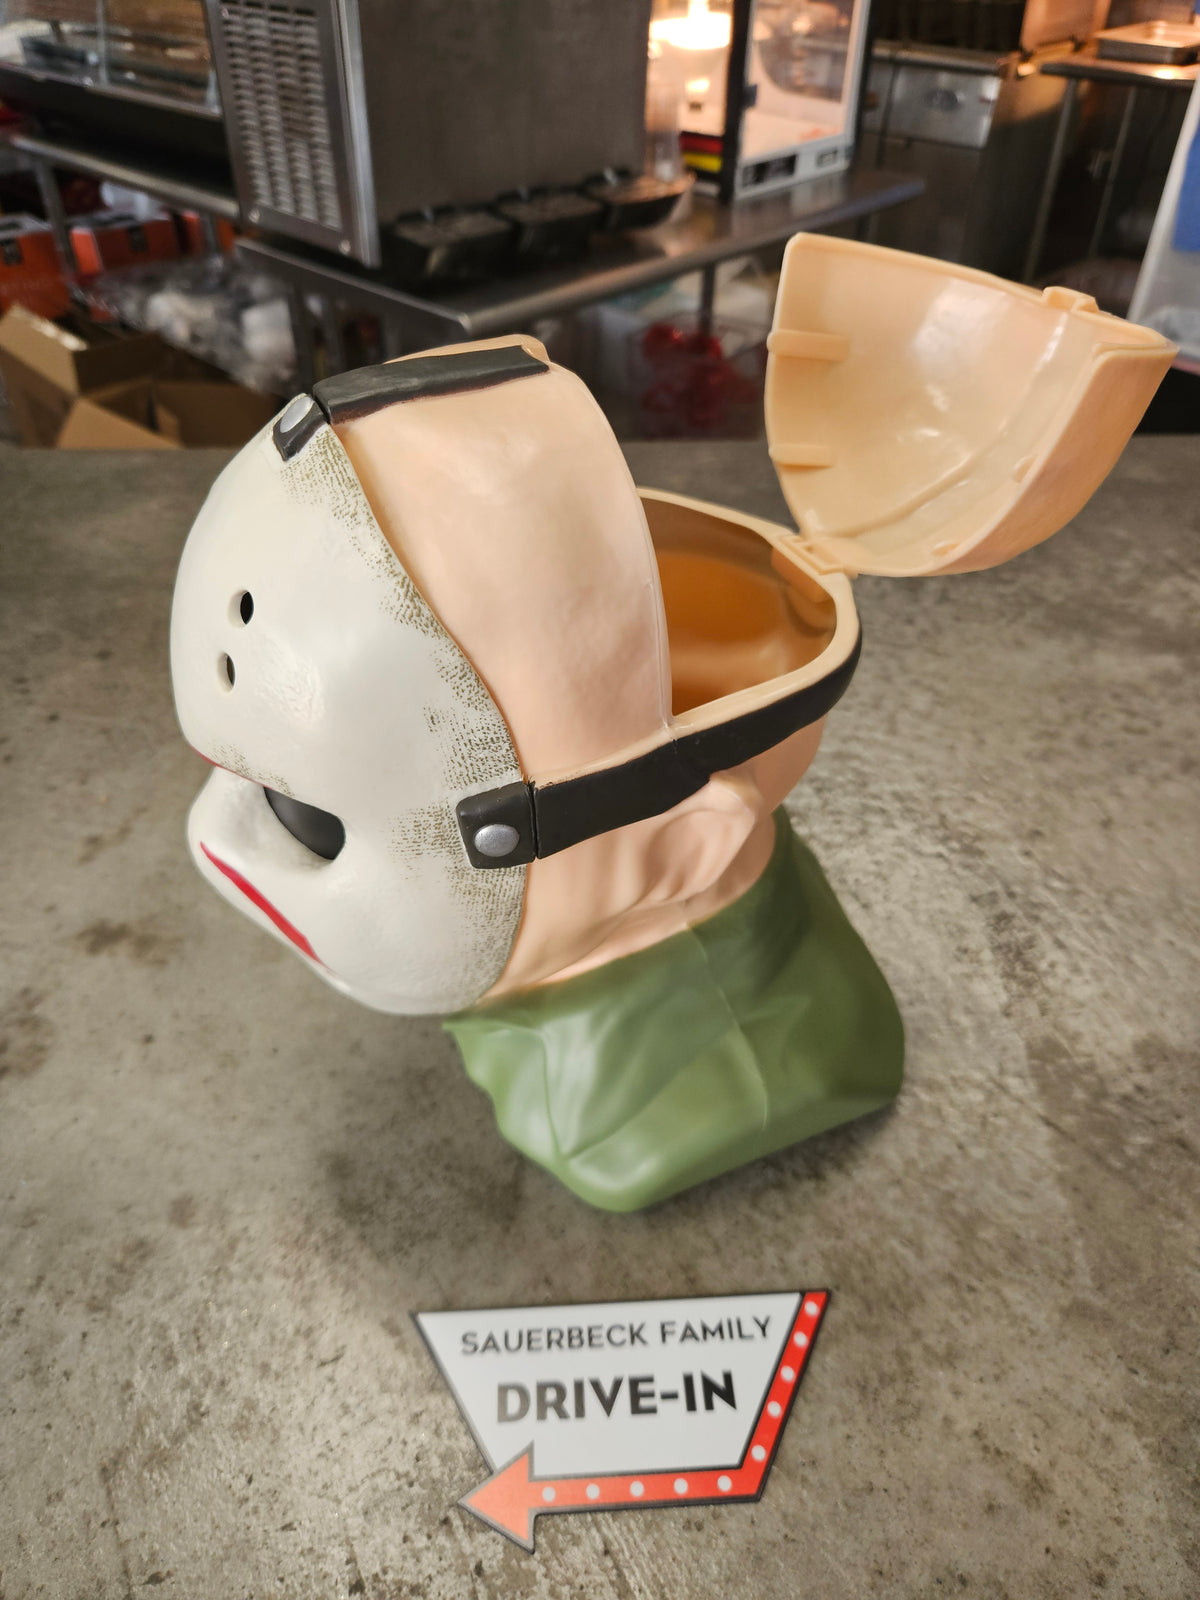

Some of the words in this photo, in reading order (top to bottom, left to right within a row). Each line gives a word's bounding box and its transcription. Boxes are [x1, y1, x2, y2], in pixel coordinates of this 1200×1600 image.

[461, 1323, 647, 1355] SAUERBECK
[660, 1315, 772, 1345] FAMILY
[496, 1370, 737, 1423] DRIVE-IN
